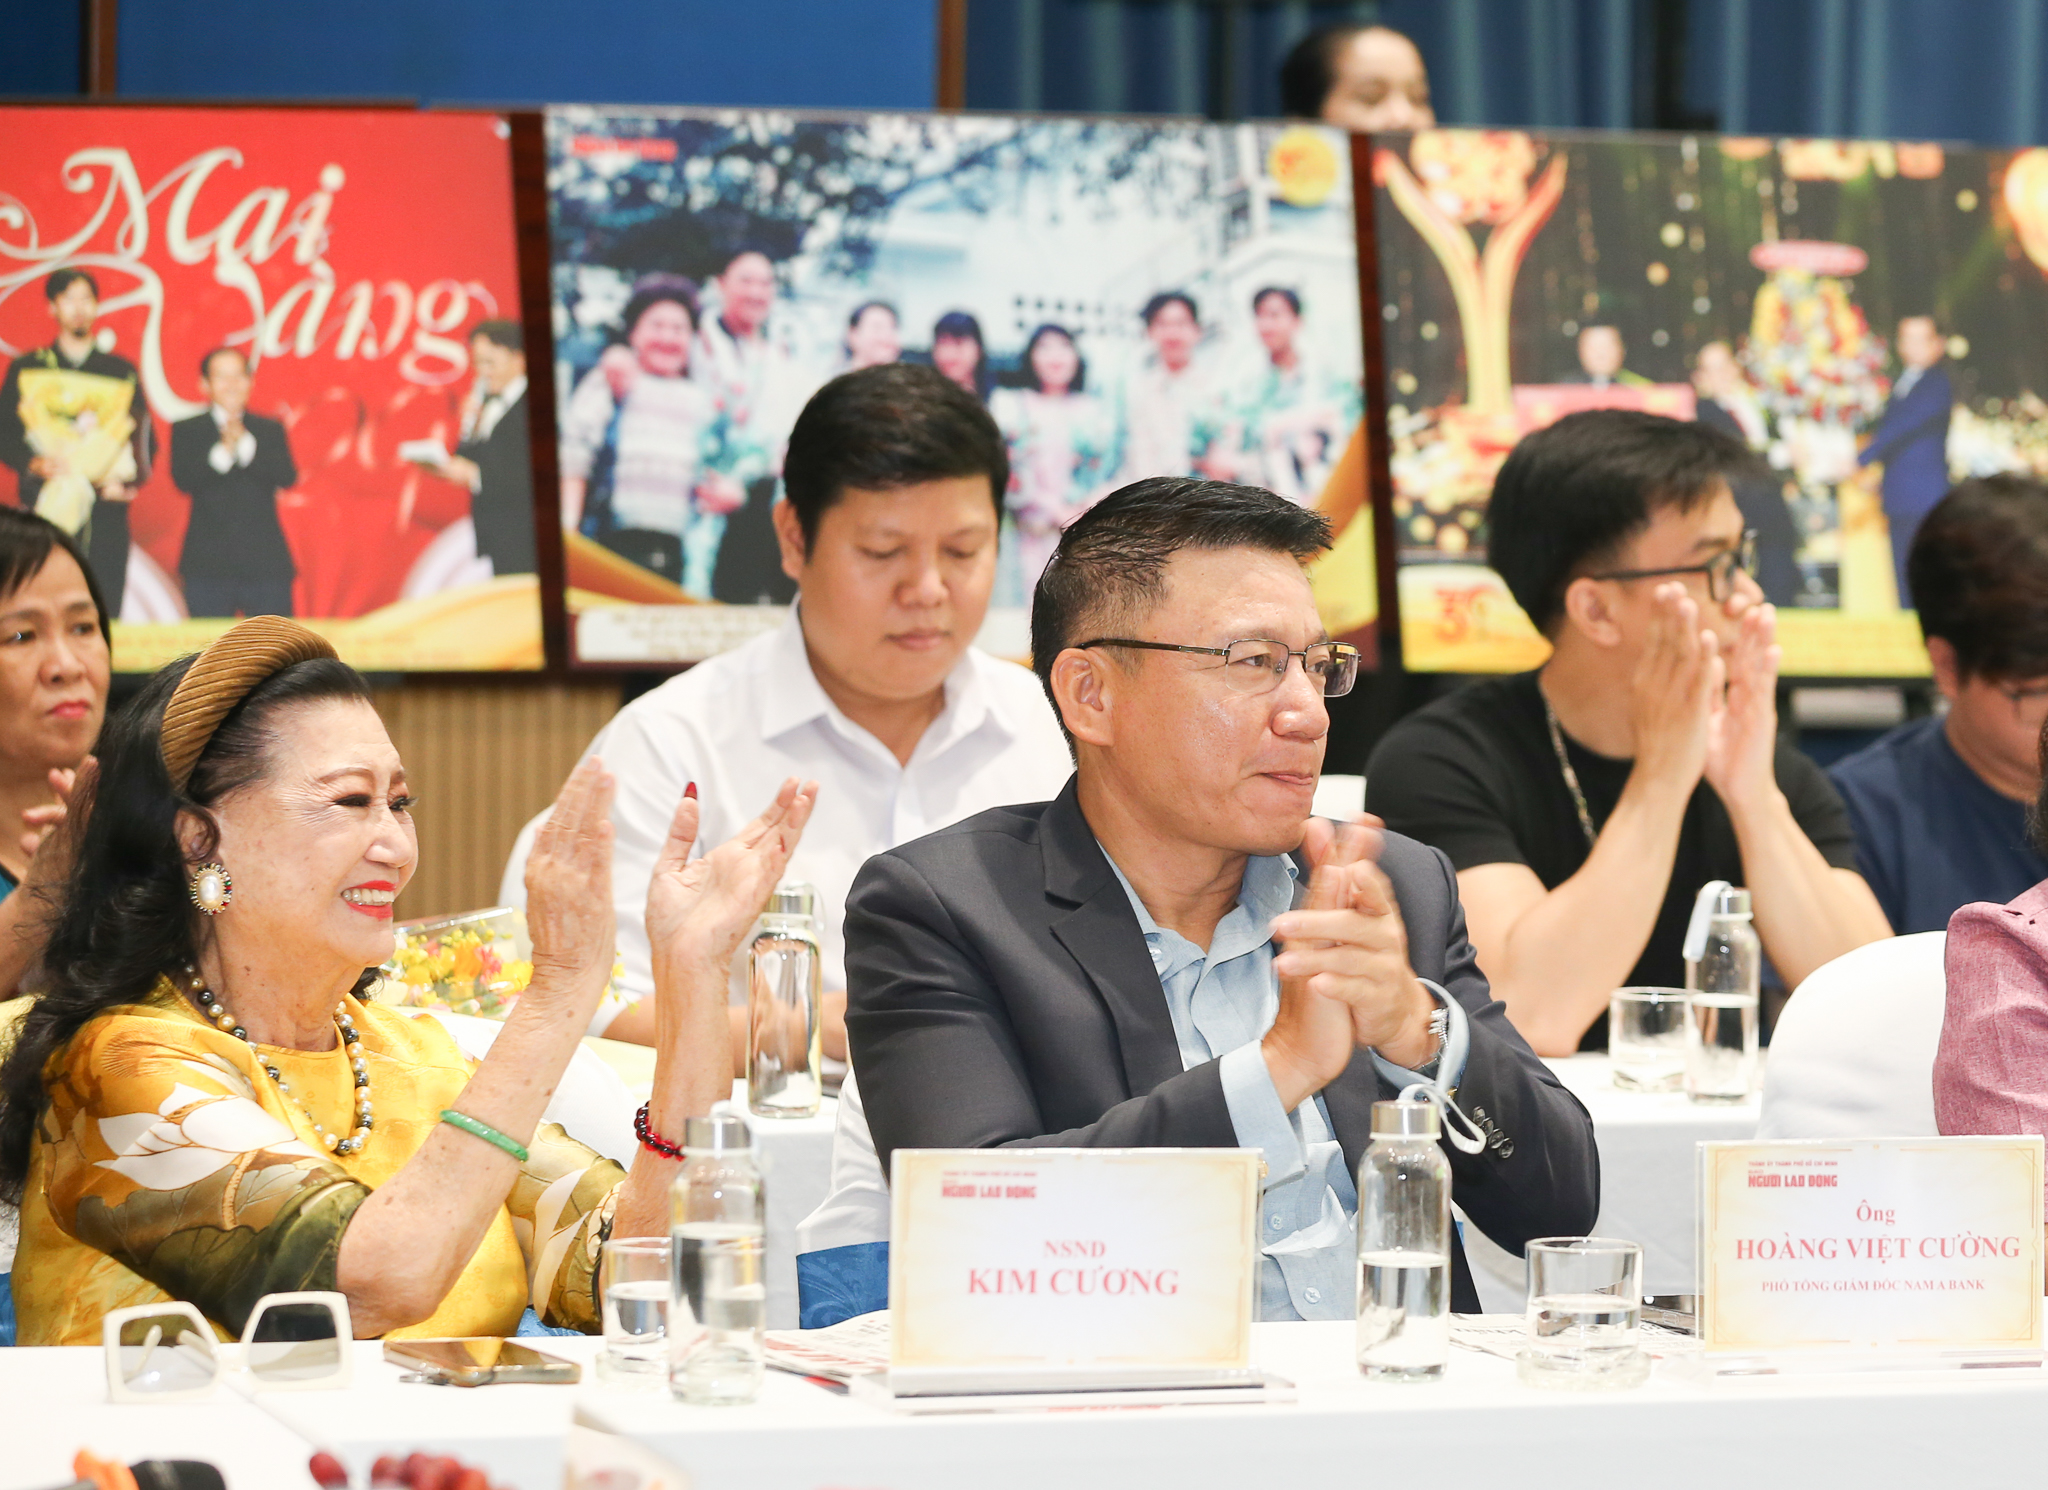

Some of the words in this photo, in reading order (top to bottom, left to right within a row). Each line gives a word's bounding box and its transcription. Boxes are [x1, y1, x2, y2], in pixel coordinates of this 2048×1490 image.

[40, 146, 346, 265] Mai
[1784, 1174, 1805, 1188] LAO
[1856, 1199, 1896, 1225] Ông
[1043, 1240, 1106, 1258] NSND
[1736, 1232, 1838, 1260] HOÀNG
[1846, 1234, 1912, 1264] VIỆT
[1918, 1230, 2020, 1259] CƯỜNG
[968, 1268, 1038, 1294] KIM
[1049, 1265, 1179, 1295] CƯƠNG
[1904, 1280, 1935, 1291] NAM
[1949, 1279, 1985, 1291] BANK
